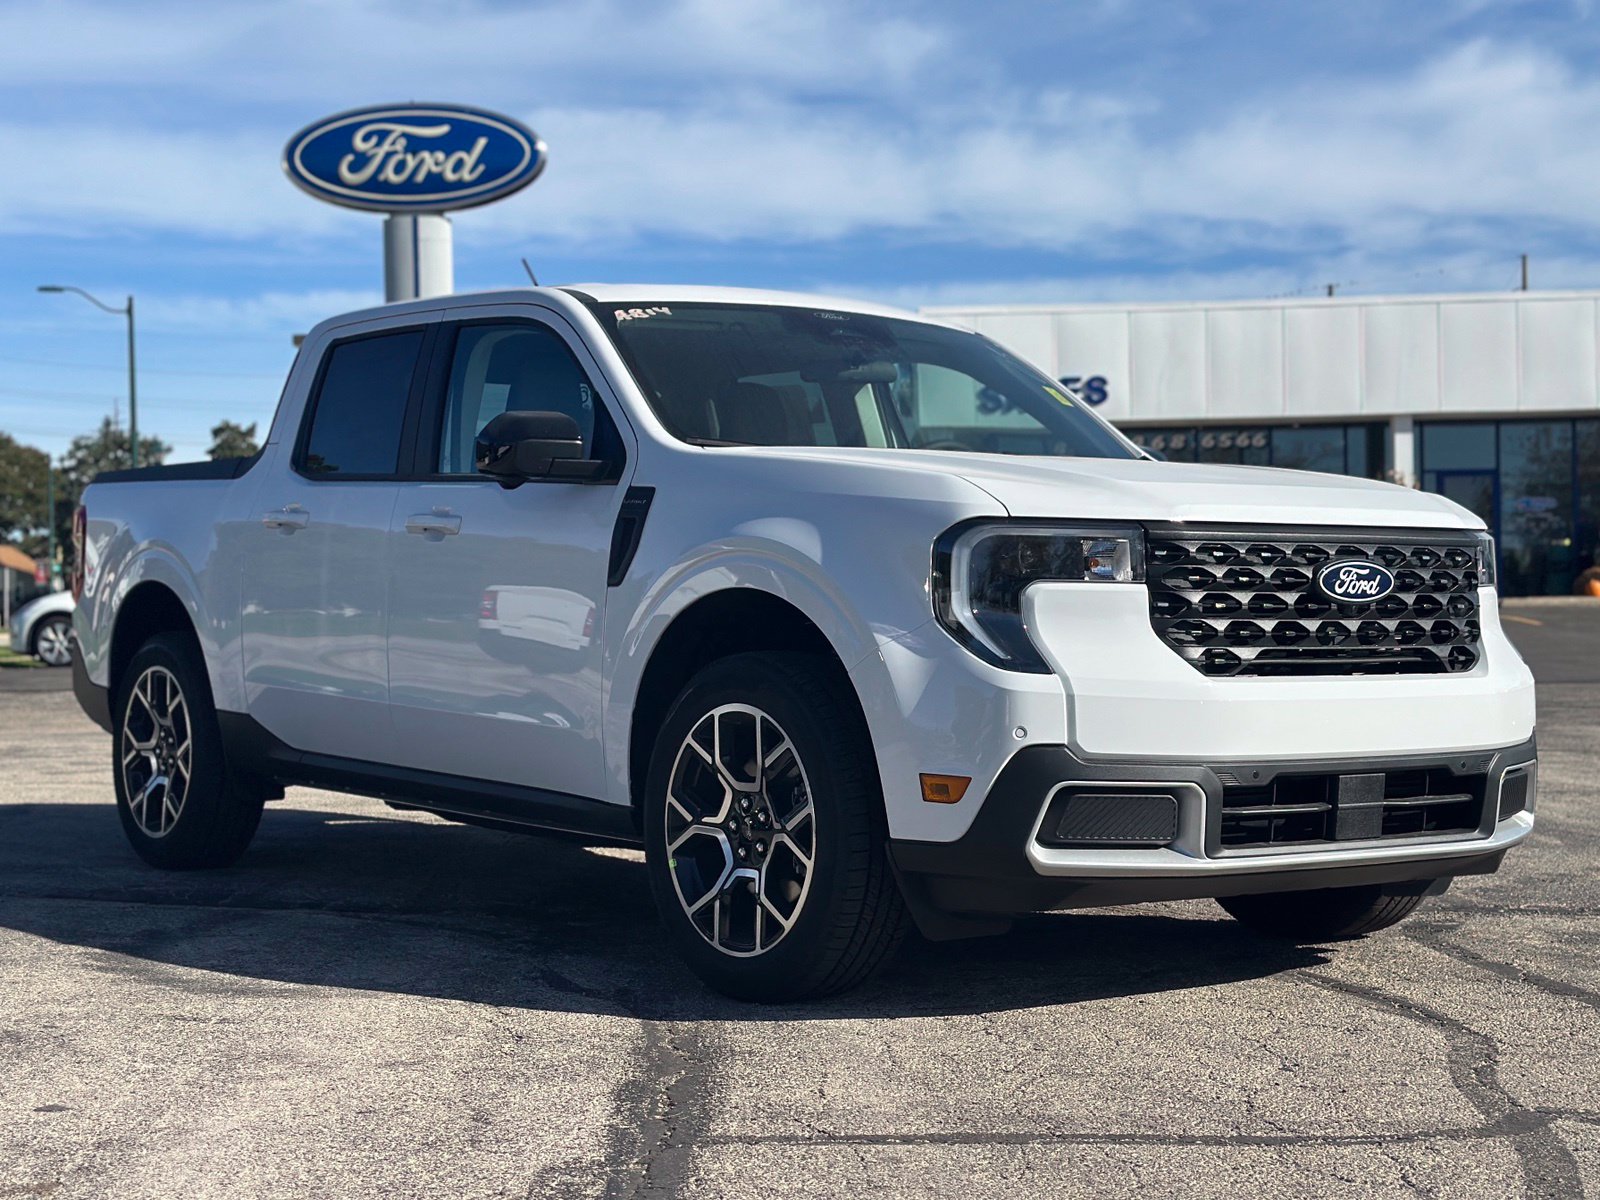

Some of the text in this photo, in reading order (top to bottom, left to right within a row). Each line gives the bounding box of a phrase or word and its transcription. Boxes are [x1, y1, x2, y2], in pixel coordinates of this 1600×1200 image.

[338, 122, 489, 186] Ford
[1201, 432, 1267, 449] 6566
[1334, 566, 1381, 595] Ford
